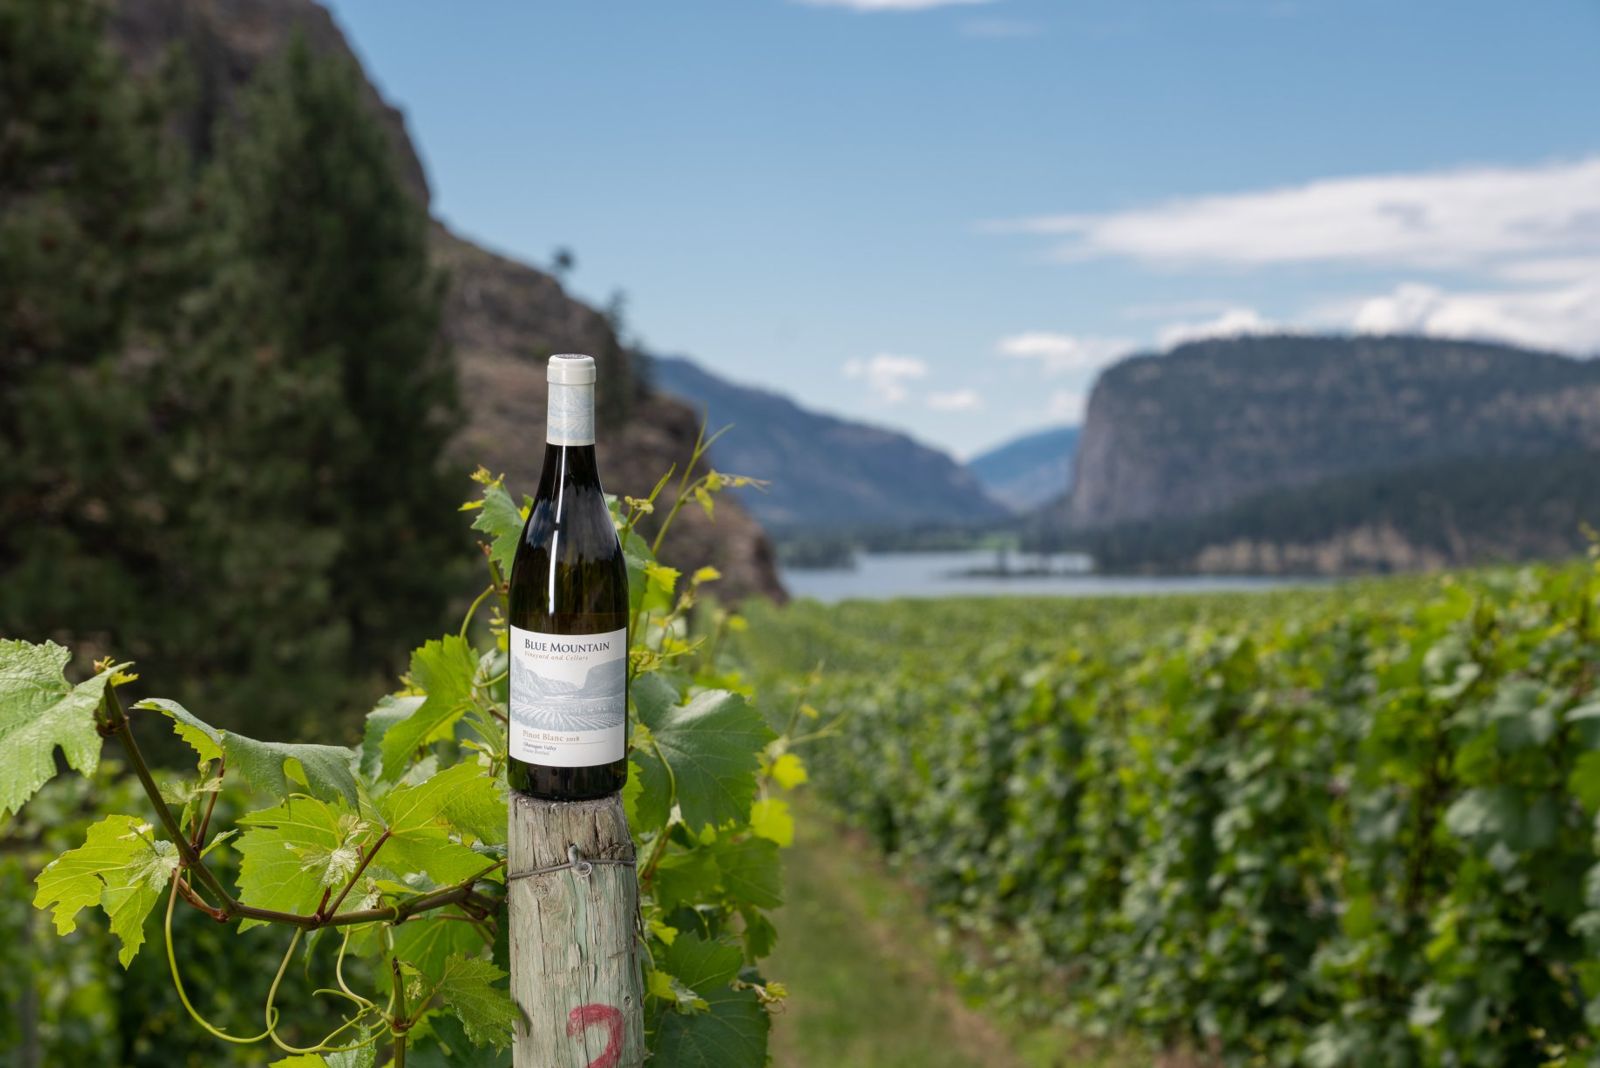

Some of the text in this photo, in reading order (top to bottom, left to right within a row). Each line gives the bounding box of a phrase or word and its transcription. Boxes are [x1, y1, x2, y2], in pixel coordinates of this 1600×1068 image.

[525, 639, 610, 652] BLUE MOUNTAIN
[525, 651, 549, 660] Vineyard
[522, 730, 540, 740] Pinot
[543, 733, 563, 742] Blanc
